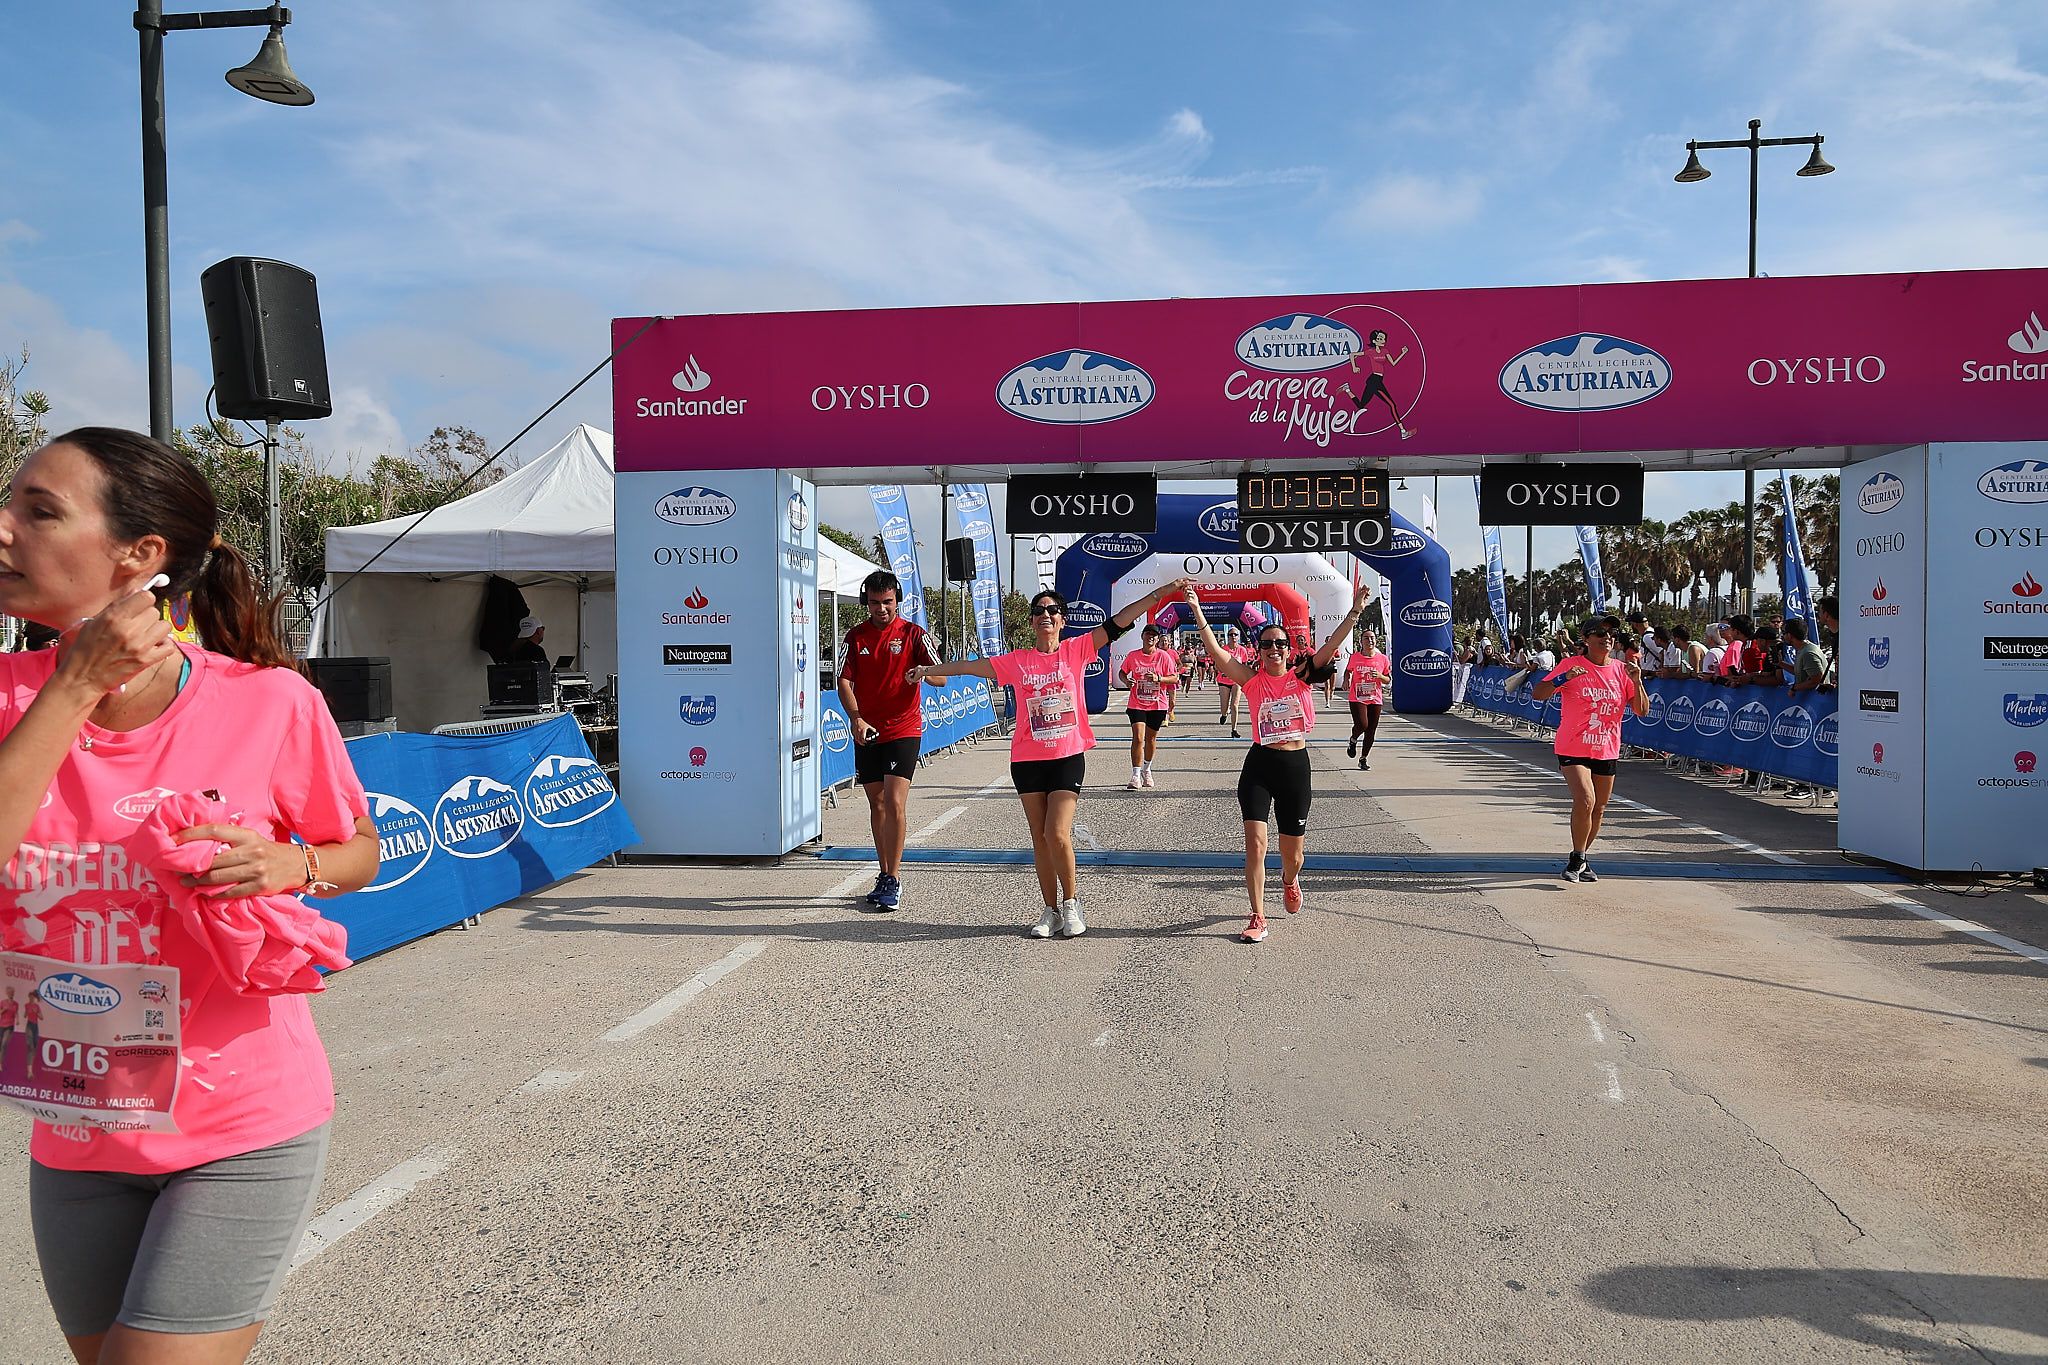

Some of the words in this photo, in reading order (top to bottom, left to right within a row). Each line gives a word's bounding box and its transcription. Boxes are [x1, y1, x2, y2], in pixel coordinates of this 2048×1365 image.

[1264, 333, 1305, 342] CENTRAL
[1307, 331, 1350, 341] LECHERA
[1245, 334, 1352, 359] ASTURIANA
[1538, 360, 1596, 370] CENTRAL
[1598, 358, 1653, 368] LECHERA
[1747, 355, 1887, 387] OYSHO
[1032, 375, 1082, 385] CENTRAL
[1086, 372, 1138, 384] LECHERA
[1224, 369, 1330, 402] Carrera
[1513, 363, 1659, 394] ASTURIANA
[811, 382, 931, 412] OYSHO
[1007, 379, 1143, 408] ASTURIANA
[636, 394, 747, 418] Santander
[1249, 401, 1269, 423] de
[1273, 400, 1287, 423] la
[1283, 396, 1368, 447] Mujer
[1248, 476, 1380, 509] 00:36:26
[1506, 483, 1621, 507] OYSHO
[1861, 488, 1901, 507] ASTURIANA
[660, 501, 731, 517] ASTURIANA
[1030, 493, 1135, 517] OYSHO
[1245, 518, 1385, 550] OYSHO
[1086, 540, 1143, 553] ASTURIANA
[1391, 539, 1422, 551] RIANA
[1856, 532, 1905, 557] OYSHO
[653, 545, 739, 566] OYSHO
[1183, 555, 1279, 575] OYSHO
[1126, 577, 1156, 585] OYSHO
[1216, 582, 1260, 591] Santander
[1306, 574, 1336, 582] OYSHO
[661, 611, 732, 625] Santander
[1403, 609, 1449, 621] ASTURIANA
[1859, 603, 1901, 618] Santander
[667, 647, 729, 663] Neutrogena
[1403, 659, 1449, 671] ASTURIANA
[1022, 669, 1065, 686] CARRERA
[681, 701, 715, 718] Marlene
[1044, 712, 1062, 722] 016
[1600, 702, 1613, 716] DE
[2005, 700, 2047, 719] Marlene
[1273, 720, 1292, 728] 016
[1772, 719, 1808, 739] ASTURIANA
[540, 778, 567, 792] CENTRAL
[566, 766, 602, 783] LECHERA
[533, 774, 614, 817] ASTURIANA
[452, 802, 486, 816] CENTRAL
[383, 816, 419, 833] LECHERA
[443, 803, 520, 846] ASTURIANA
[379, 828, 429, 864] RIANA
[6, 966, 37, 982] SUMA
[43, 983, 113, 1007] ASTURIANA
[42, 1040, 110, 1075] 016
[115, 1048, 175, 1057] CORREDORA
[62, 1076, 86, 1092] 544
[40, 1089, 52, 1100] DE
[53, 1091, 65, 1102] LA
[66, 1094, 97, 1107] MUJER
[106, 1097, 155, 1108] VALENCIA
